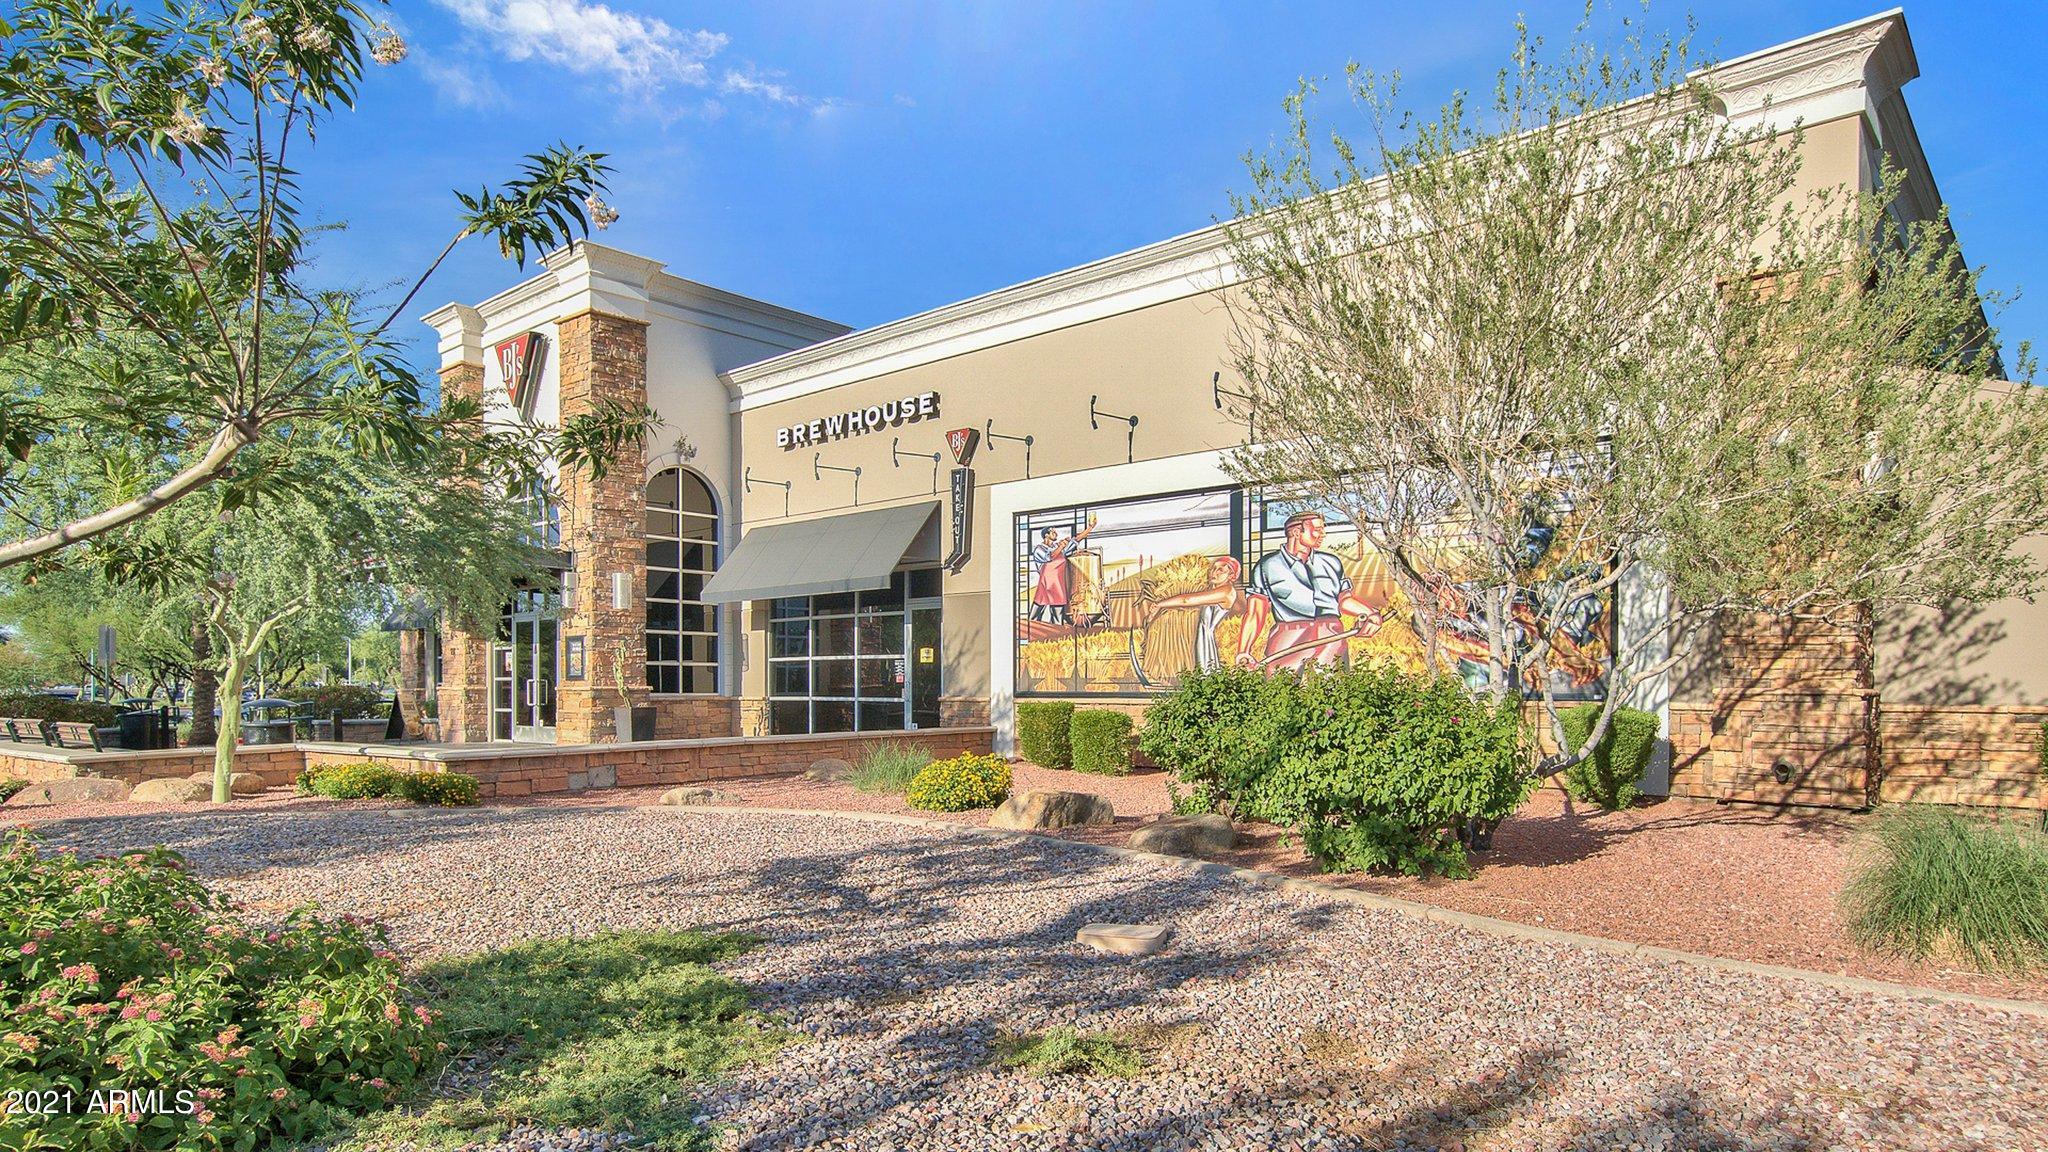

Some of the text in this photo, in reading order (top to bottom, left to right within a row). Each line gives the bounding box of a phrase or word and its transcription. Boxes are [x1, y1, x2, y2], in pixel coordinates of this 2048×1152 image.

[502, 342, 523, 390] BJ's
[776, 391, 937, 449] BREWHOUSE
[951, 432, 966, 452] BJ's
